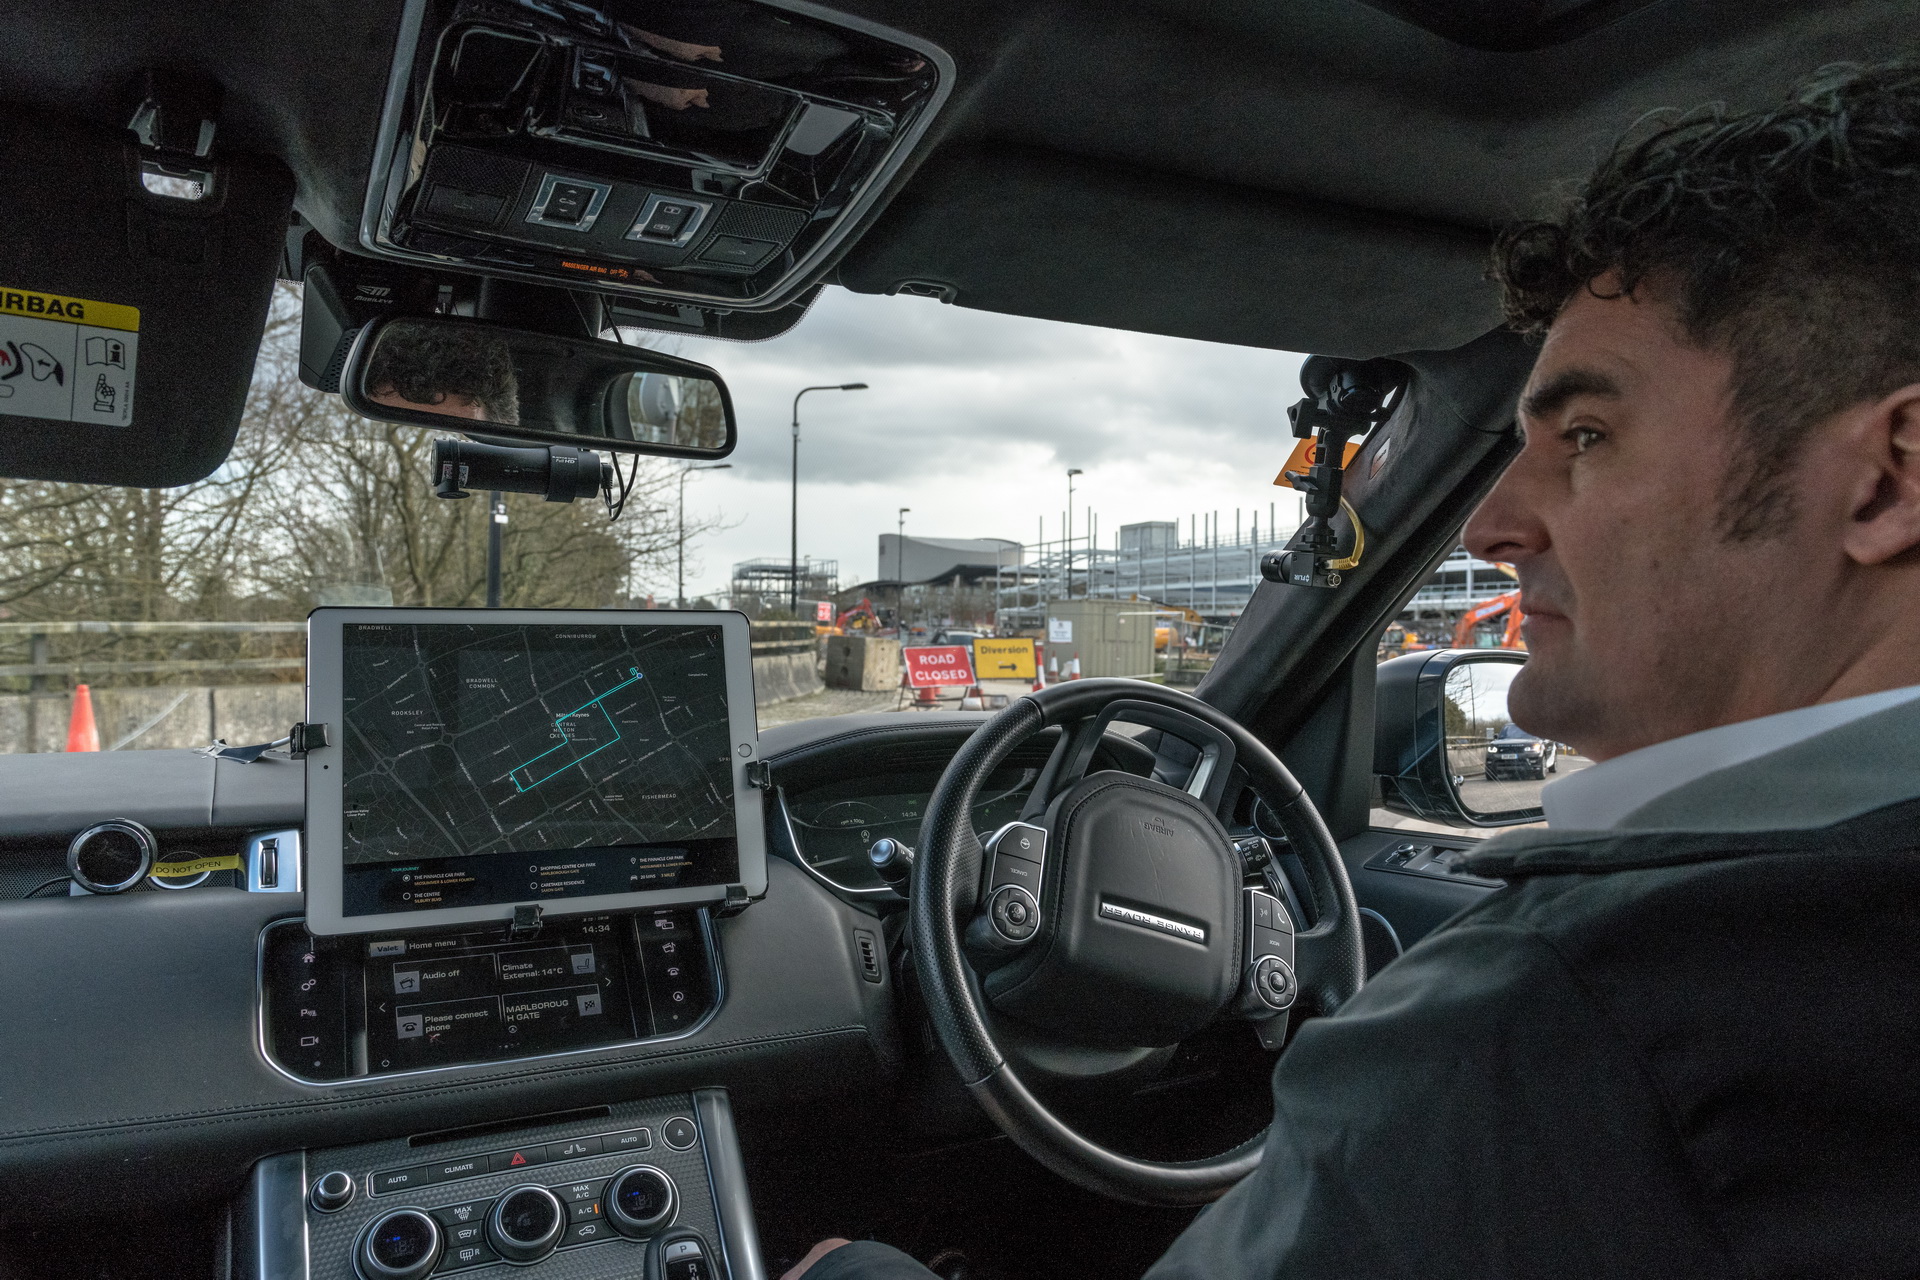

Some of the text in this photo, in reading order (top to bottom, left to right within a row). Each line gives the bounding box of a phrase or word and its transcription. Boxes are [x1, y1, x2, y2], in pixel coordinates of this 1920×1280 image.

[562, 262, 589, 270] PASSENGER
[980, 646, 1028, 654] Diversion
[919, 654, 956, 665] ROAD
[915, 669, 968, 680] CLOSED
[1144, 822, 1174, 838] AIRBAG
[156, 860, 222, 874] DO NOT OPEN
[1010, 868, 1028, 877] CANCEL
[1104, 906, 1201, 938] RANGE ROVER
[582, 924, 610, 934] 14:34
[376, 944, 399, 952] Valet
[409, 941, 432, 950] Home
[502, 962, 533, 972] Climate
[422, 969, 460, 980] Audio off
[503, 966, 564, 980] External: 14°C
[506, 1000, 570, 1014] MARLBOROUG
[424, 1010, 488, 1024] Please connect
[507, 1012, 540, 1022] H GATE
[425, 1024, 450, 1034] phone
[620, 1136, 638, 1144] AUTO
[444, 1162, 474, 1174] CLIMATE
[388, 1175, 408, 1184] AUTO
[572, 1184, 590, 1192] MAX
[576, 1192, 590, 1200] A/C
[454, 1206, 472, 1214] MAX
[578, 1207, 592, 1216] A/C
[680, 1244, 687, 1253] P
[688, 1263, 698, 1274] R
